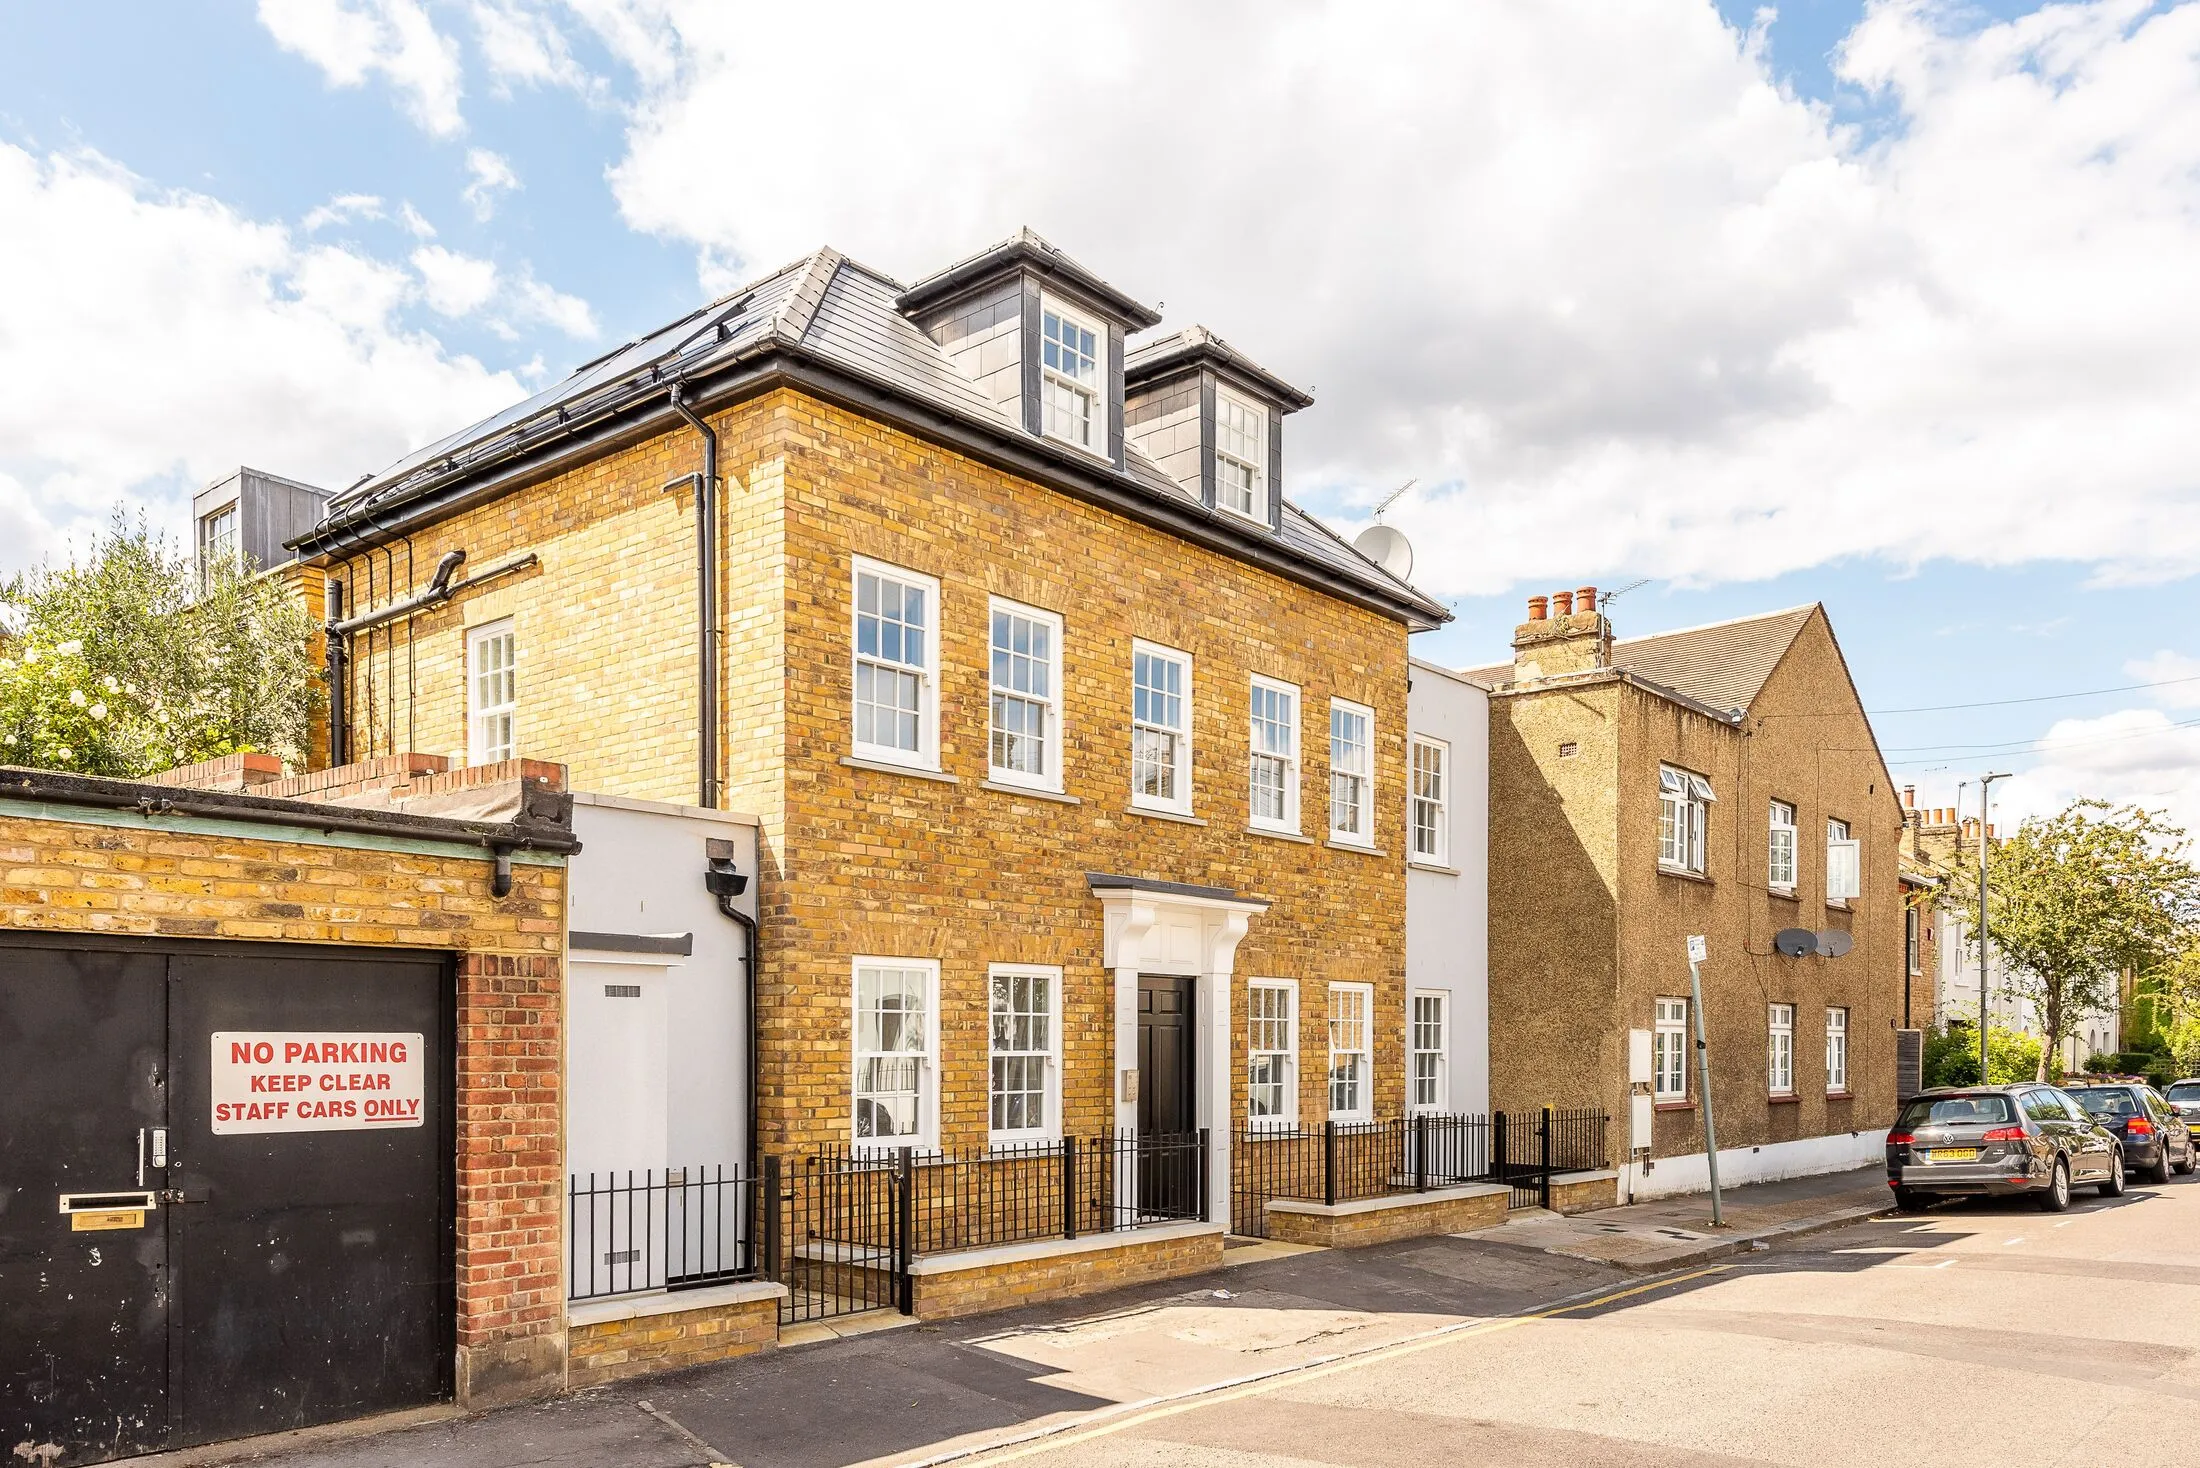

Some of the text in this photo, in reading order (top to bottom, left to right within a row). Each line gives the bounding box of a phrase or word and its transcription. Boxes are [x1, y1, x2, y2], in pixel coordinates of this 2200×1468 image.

[232, 1042, 407, 1064] NO PARKING
[251, 1074, 390, 1092] KEEP CLEAR
[216, 1099, 420, 1121] STAFF CARS ONLY
